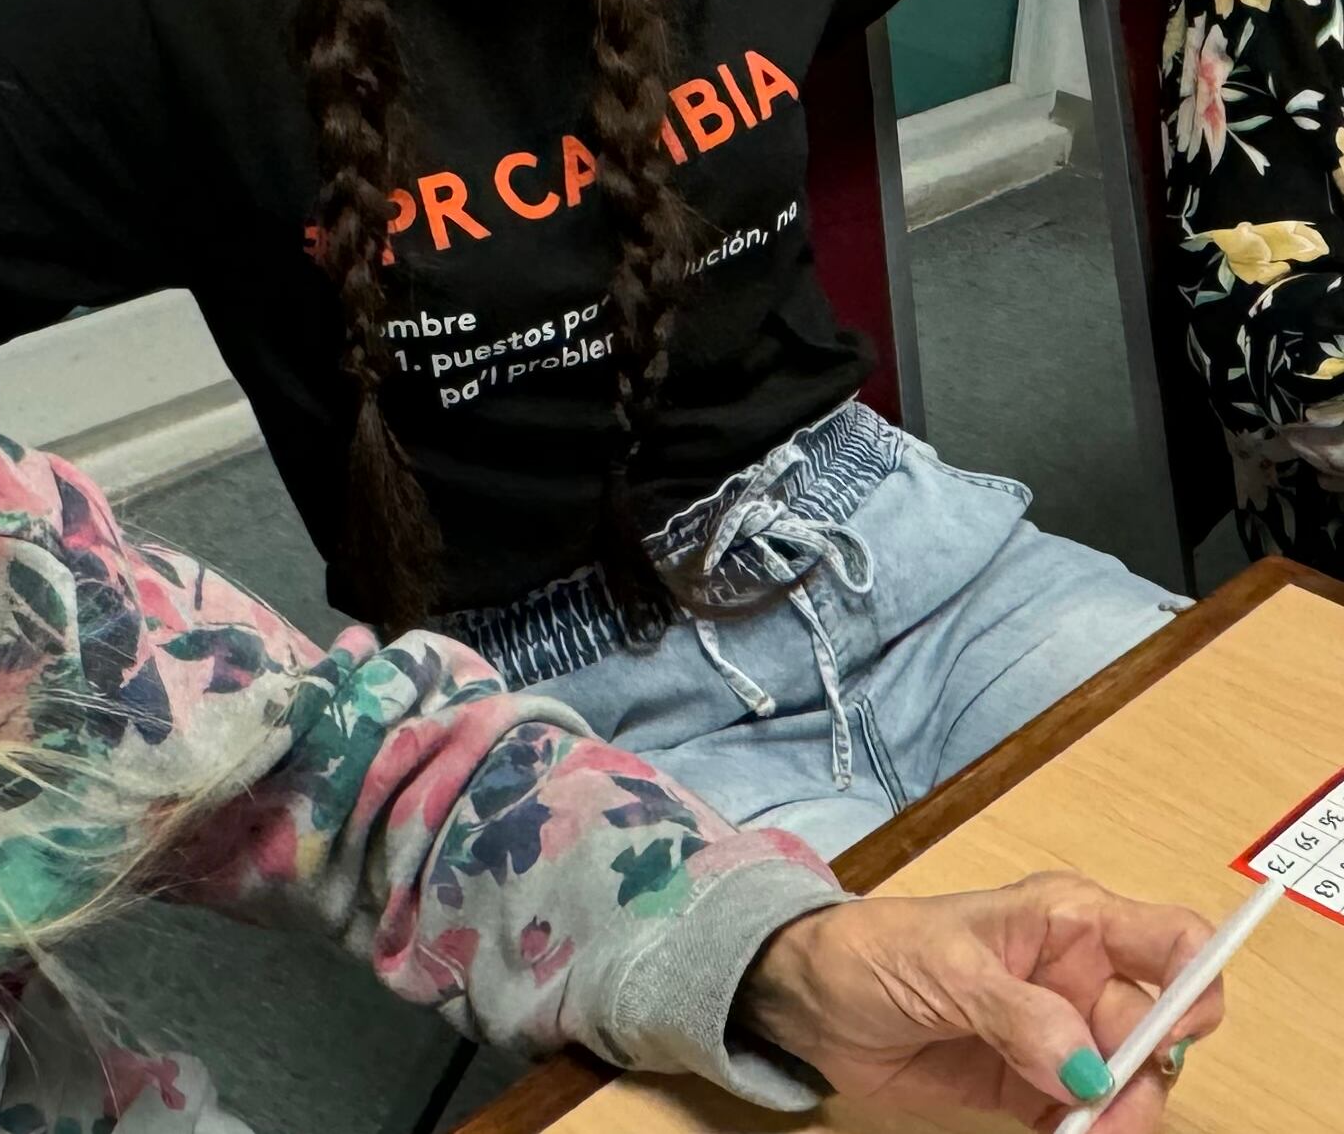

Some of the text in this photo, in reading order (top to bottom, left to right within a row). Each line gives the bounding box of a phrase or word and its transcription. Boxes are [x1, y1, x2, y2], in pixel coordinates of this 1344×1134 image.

[304, 171, 492, 266] PR
[394, 350, 422, 372] 1.
[431, 320, 556, 378] puestos
[776, 201, 797, 232] no
[380, 311, 477, 338] mbre
[440, 366, 497, 409] pa'l
[1294, 831, 1320, 852] 59
[1267, 853, 1296, 875] 73
[1313, 879, 1341, 899] 63
